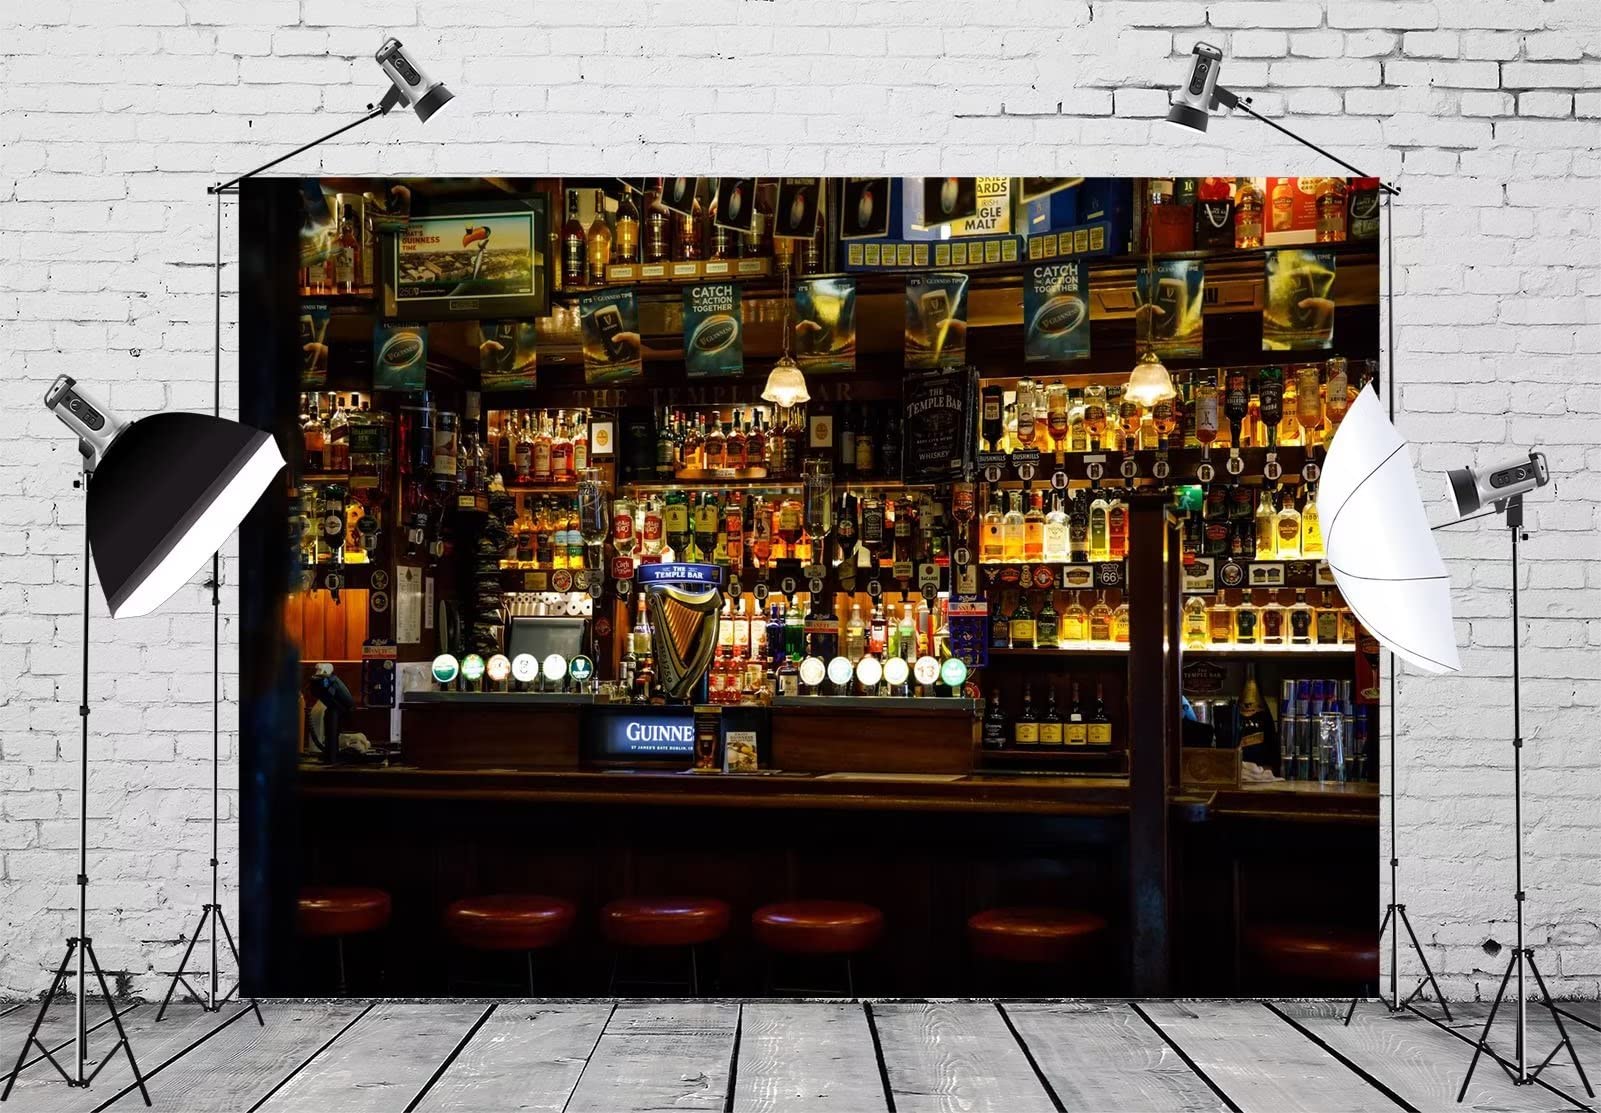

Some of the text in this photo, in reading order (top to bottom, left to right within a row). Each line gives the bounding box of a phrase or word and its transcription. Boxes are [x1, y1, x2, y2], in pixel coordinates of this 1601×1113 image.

[965, 219, 997, 231] MALT
[402, 236, 441, 244] GUINNESS
[1033, 263, 1079, 278] CATCH
[1044, 276, 1079, 286] ACTION
[692, 285, 733, 298] CATCH
[1034, 284, 1079, 295] TOGETHER
[702, 296, 733, 305] ACTION
[692, 303, 733, 313] TOGETHER
[705, 326, 733, 343] GUINNESS
[929, 387, 944, 396] THE
[572, 388, 628, 408] THE
[907, 394, 962, 419] TEMPLE BAR
[919, 450, 949, 461] WHISKEY
[979, 454, 1007, 463] BUSHMILLS
[1012, 451, 1040, 461] BUSHMILLS
[655, 571, 705, 580] TEMPLE BAR
[1103, 573, 1117, 583] 66
[626, 722, 696, 743] GUINNE
